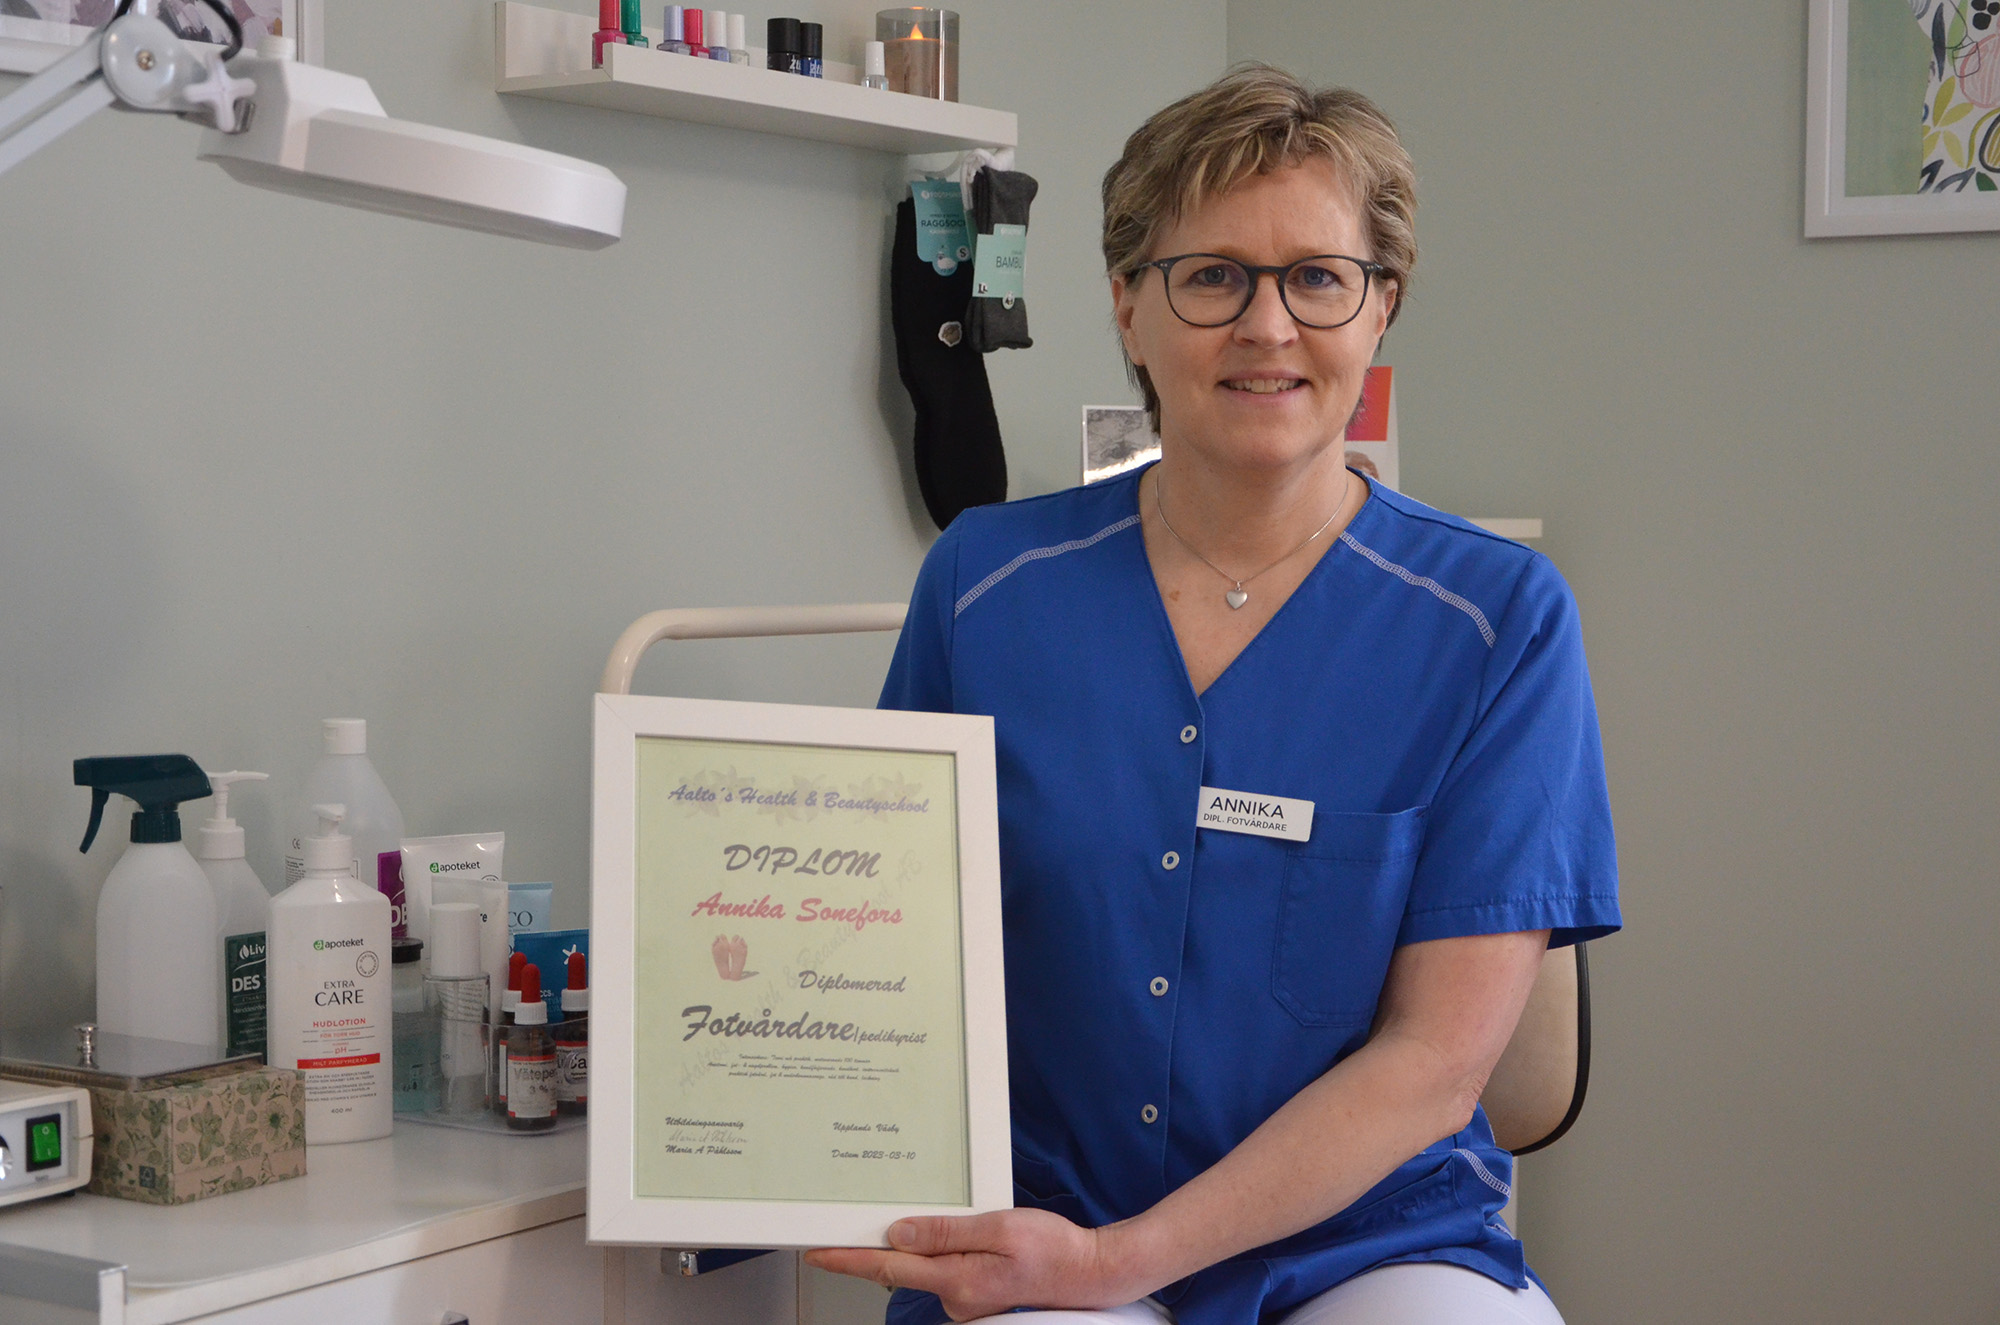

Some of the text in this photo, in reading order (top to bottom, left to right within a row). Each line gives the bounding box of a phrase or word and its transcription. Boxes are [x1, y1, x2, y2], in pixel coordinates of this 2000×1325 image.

[959, 248, 967, 258] S
[738, 786, 798, 807] Health
[804, 790, 818, 807] &
[824, 791, 929, 815] Beautyschool
[1210, 796, 1284, 819] ANNIKA
[1203, 813, 1288, 832] DIPL. FOTVÅRDARE
[439, 861, 481, 873] apoteket
[723, 844, 882, 879] DIPLOM
[691, 891, 903, 931] Annika Sonefors
[324, 938, 364, 950] apoteket
[232, 974, 261, 993] DES
[323, 980, 355, 990] EXTRA
[798, 970, 906, 994] Diplomerad
[314, 989, 364, 1007] CARE
[313, 1018, 366, 1028] HUDLOTION
[665, 1116, 744, 1130] Utbildningsansvarig
[833, 1121, 900, 1135] Upplands Väsby
[665, 1144, 742, 1155] Maria A Påhlsson
[832, 1149, 916, 1160] Datum 2023-03-10
